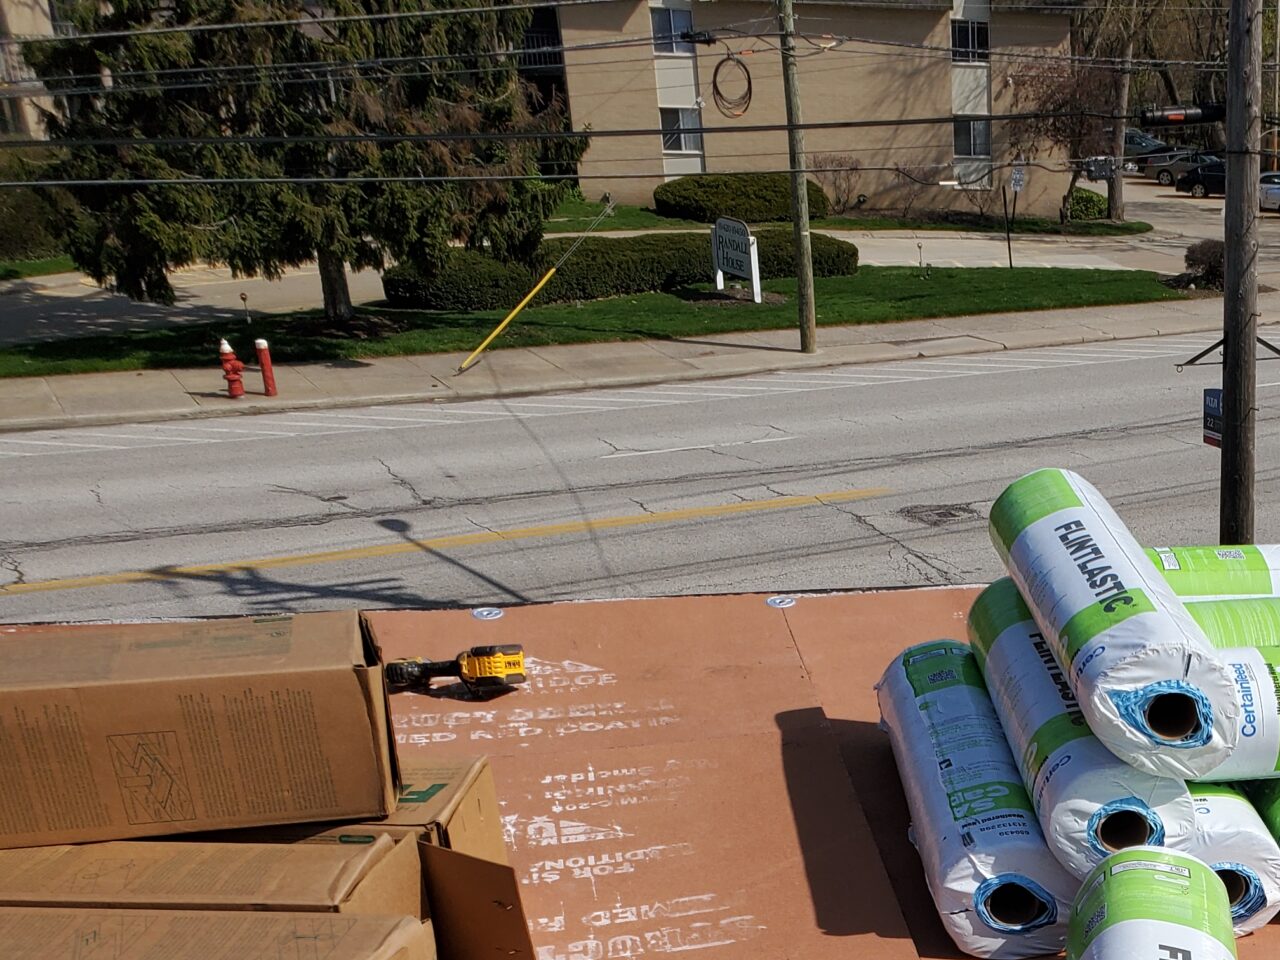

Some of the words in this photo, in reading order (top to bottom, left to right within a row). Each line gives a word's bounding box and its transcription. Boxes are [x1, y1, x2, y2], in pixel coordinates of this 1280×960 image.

[718, 235, 749, 255] RANDALL
[722, 251, 745, 272] HOUSE
[1053, 519, 1134, 613] FLINTLASTIC
[1228, 662, 1257, 738] CertainTeed
[981, 813, 1025, 824] Weathered
